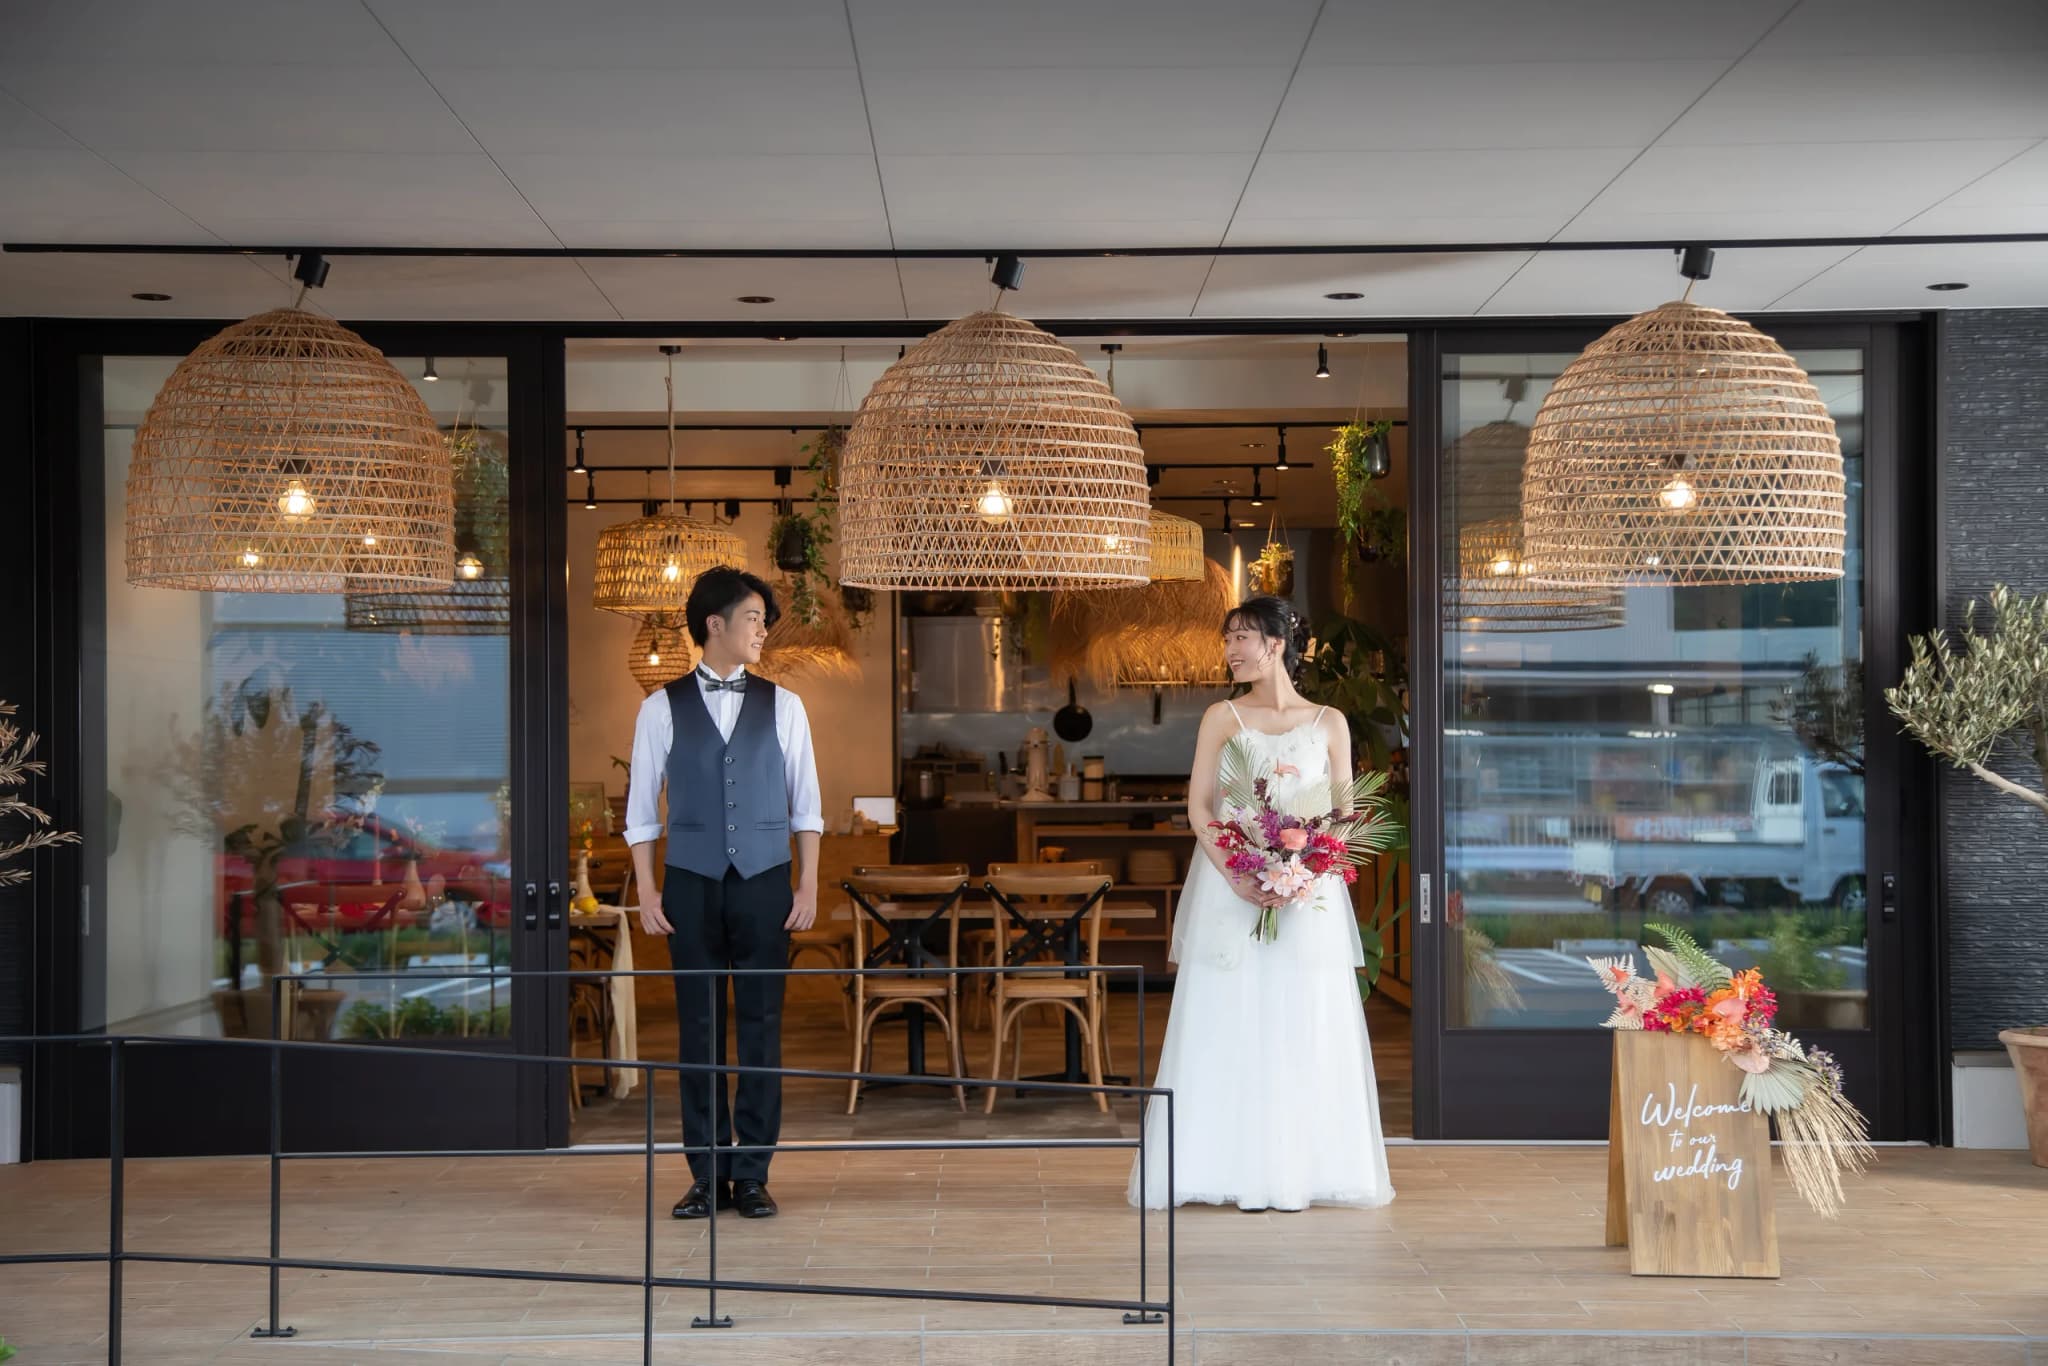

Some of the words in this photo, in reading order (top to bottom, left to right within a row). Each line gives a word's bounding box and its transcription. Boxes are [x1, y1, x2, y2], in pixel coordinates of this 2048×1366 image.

[1640, 1082, 1752, 1128] Welcome
[1668, 1130, 1683, 1153] to
[1689, 1133, 1717, 1146] our
[1652, 1145, 1744, 1191] wedding
